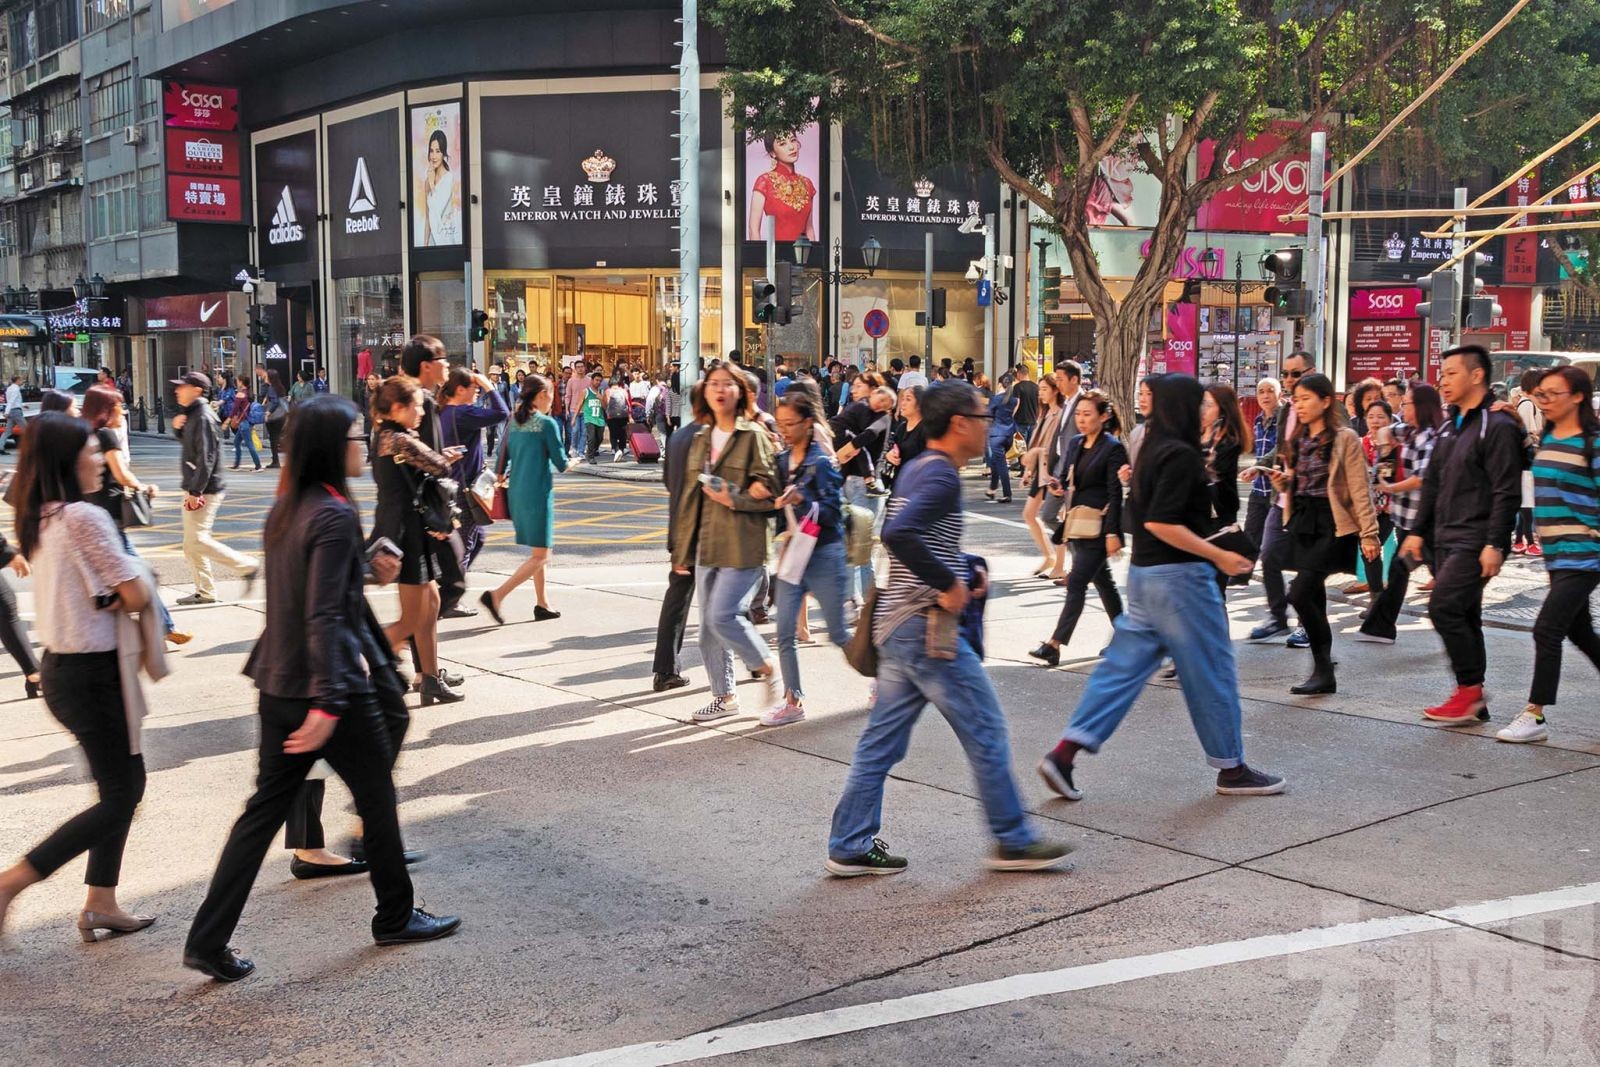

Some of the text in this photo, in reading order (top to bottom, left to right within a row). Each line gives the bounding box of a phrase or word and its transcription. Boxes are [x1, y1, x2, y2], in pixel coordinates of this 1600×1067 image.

[181, 90, 223, 109] Sasa
[184, 190, 226, 206] 特賣場
[504, 209, 681, 221] EMPEROR WATCH AND JEWELLE
[861, 213, 897, 222] EMPEROR
[898, 214, 925, 224] WATCH
[925, 215, 941, 224] AND
[345, 214, 380, 234] Reebok
[269, 222, 304, 245] adidas
[1411, 249, 1440, 261] Emperor
[1441, 250, 1453, 260] Na
[1368, 293, 1403, 309] Sasa
[101, 316, 121, 328] 名店
[1168, 339, 1193, 351] Sasa
